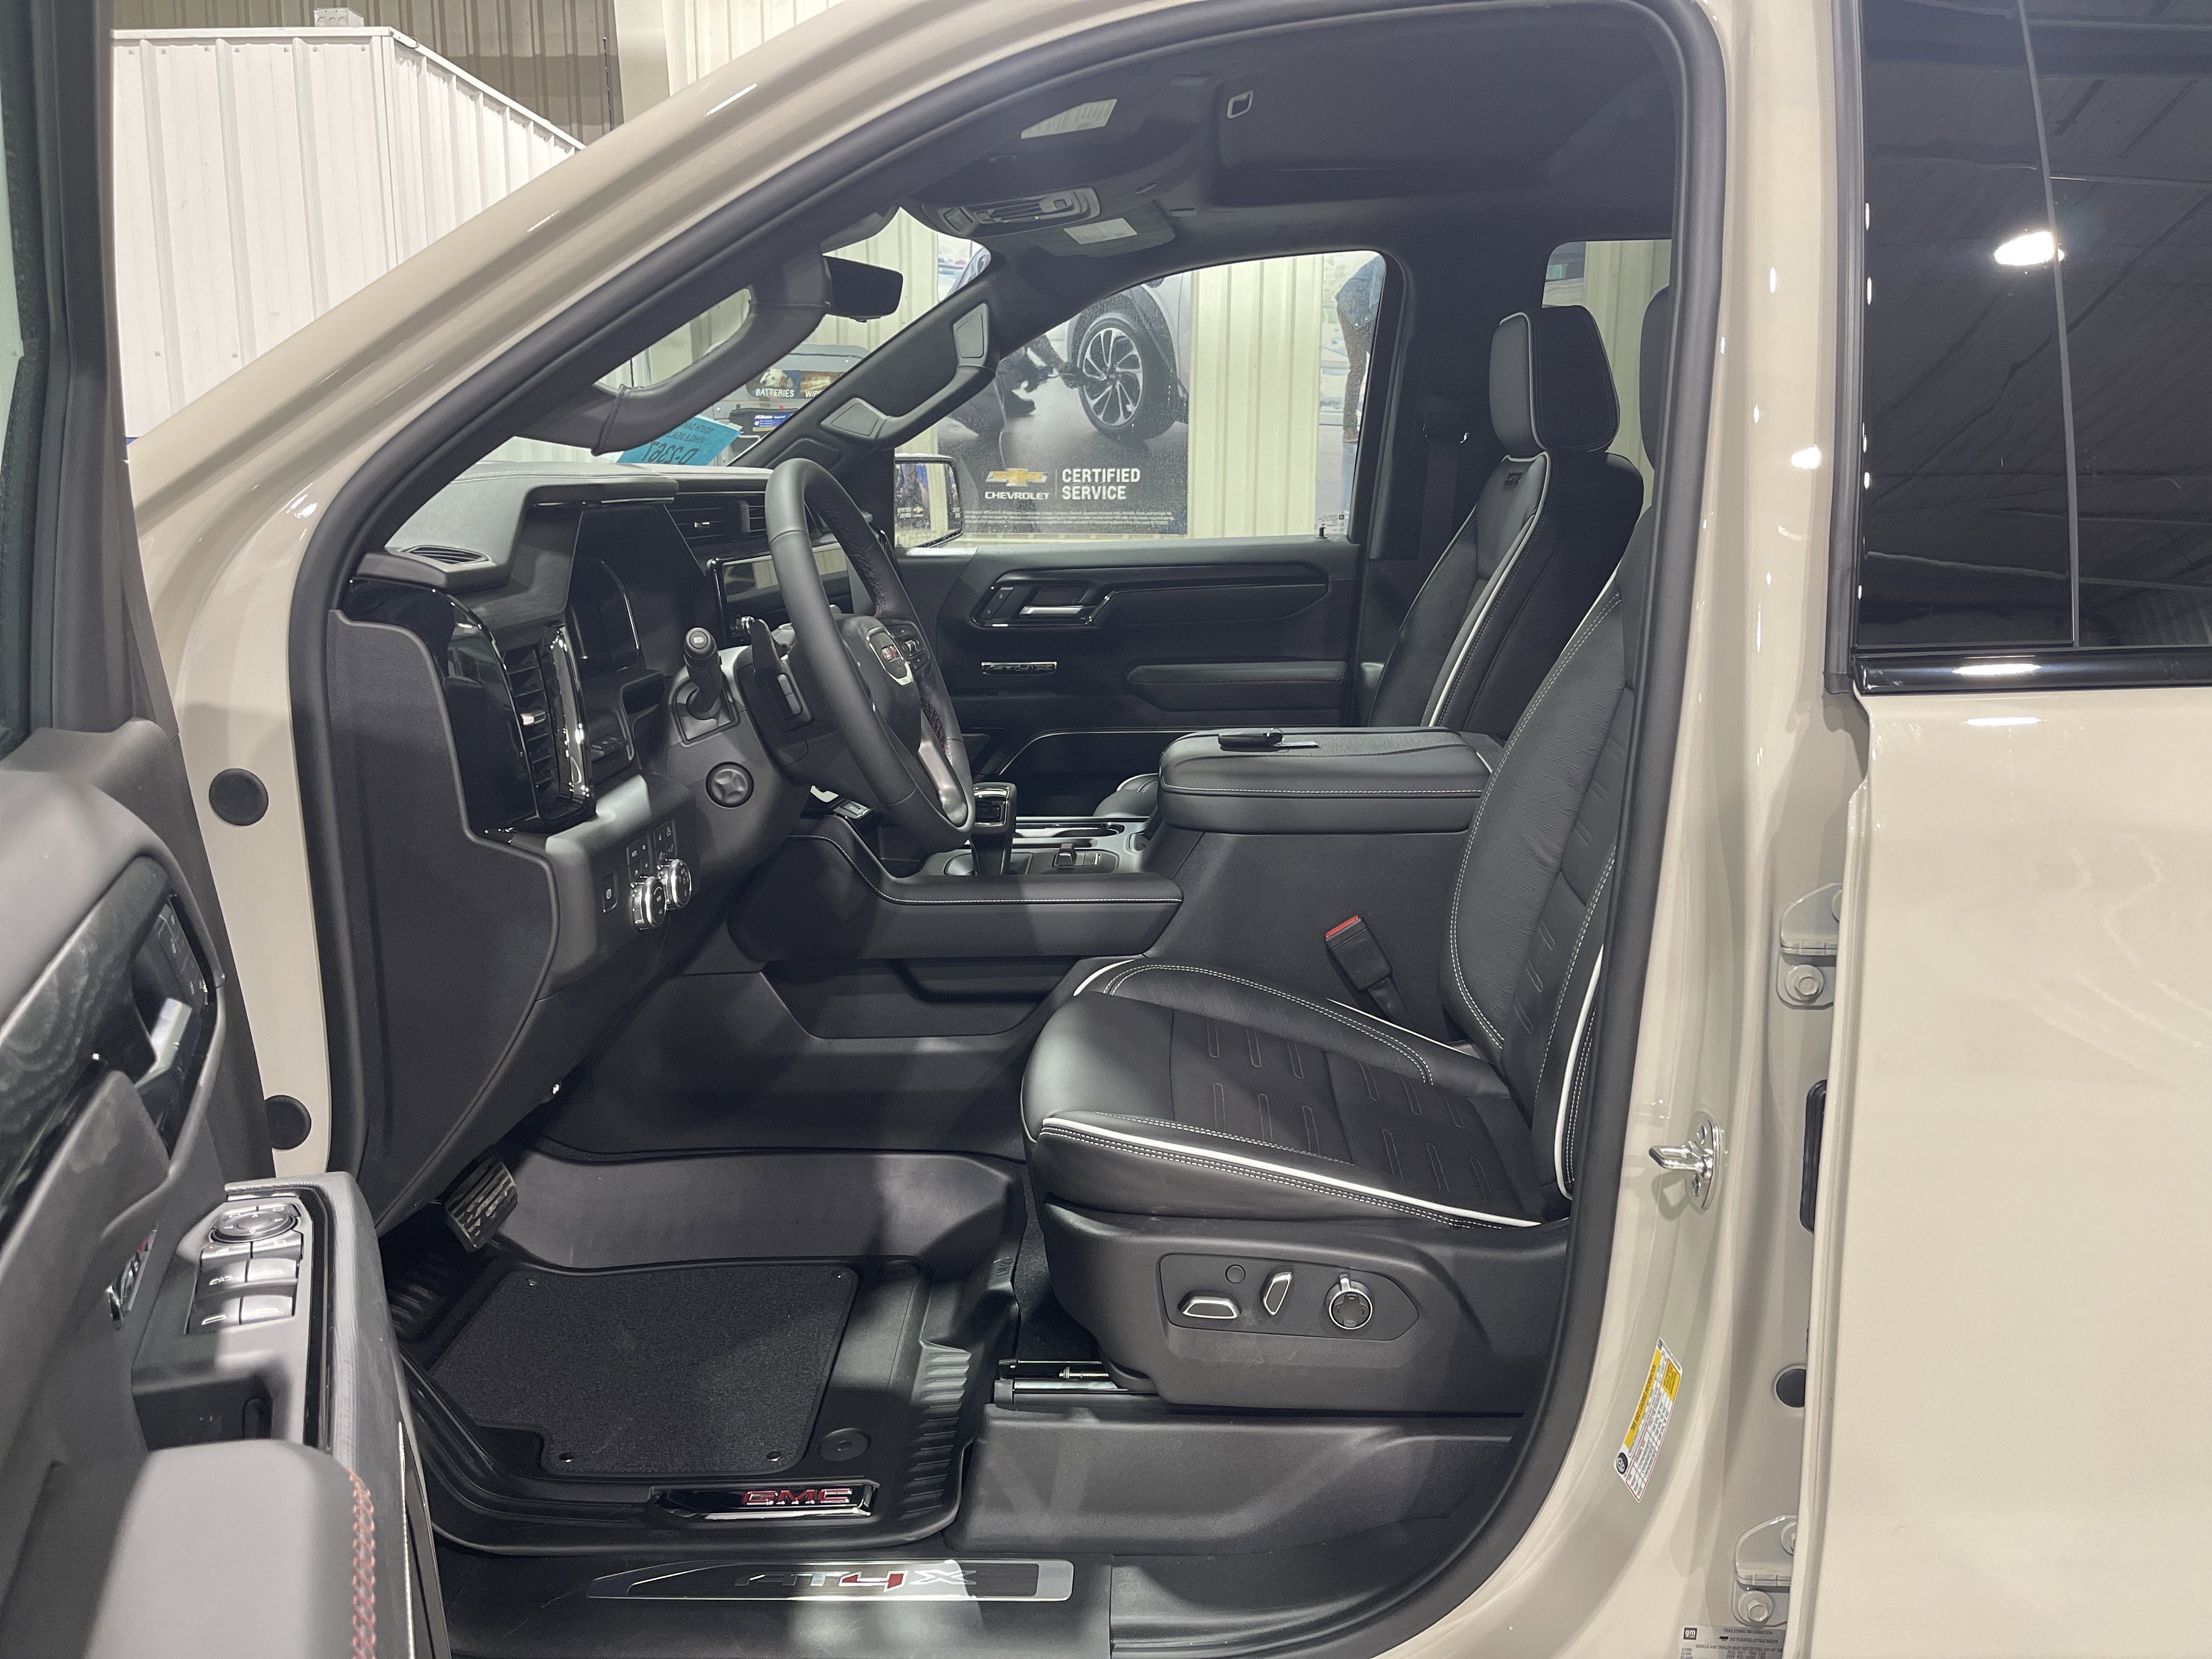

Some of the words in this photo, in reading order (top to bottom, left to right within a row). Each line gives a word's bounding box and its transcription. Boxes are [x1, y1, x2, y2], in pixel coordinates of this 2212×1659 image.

[755, 388, 794, 398] BATTERIES
[1062, 469, 1141, 483] CERTIFIED
[985, 492, 1050, 500] CHEVROLET
[1062, 486, 1127, 500] SERVICE
[743, 1488, 852, 1505] GMC
[734, 1570, 977, 1592] AT4X
